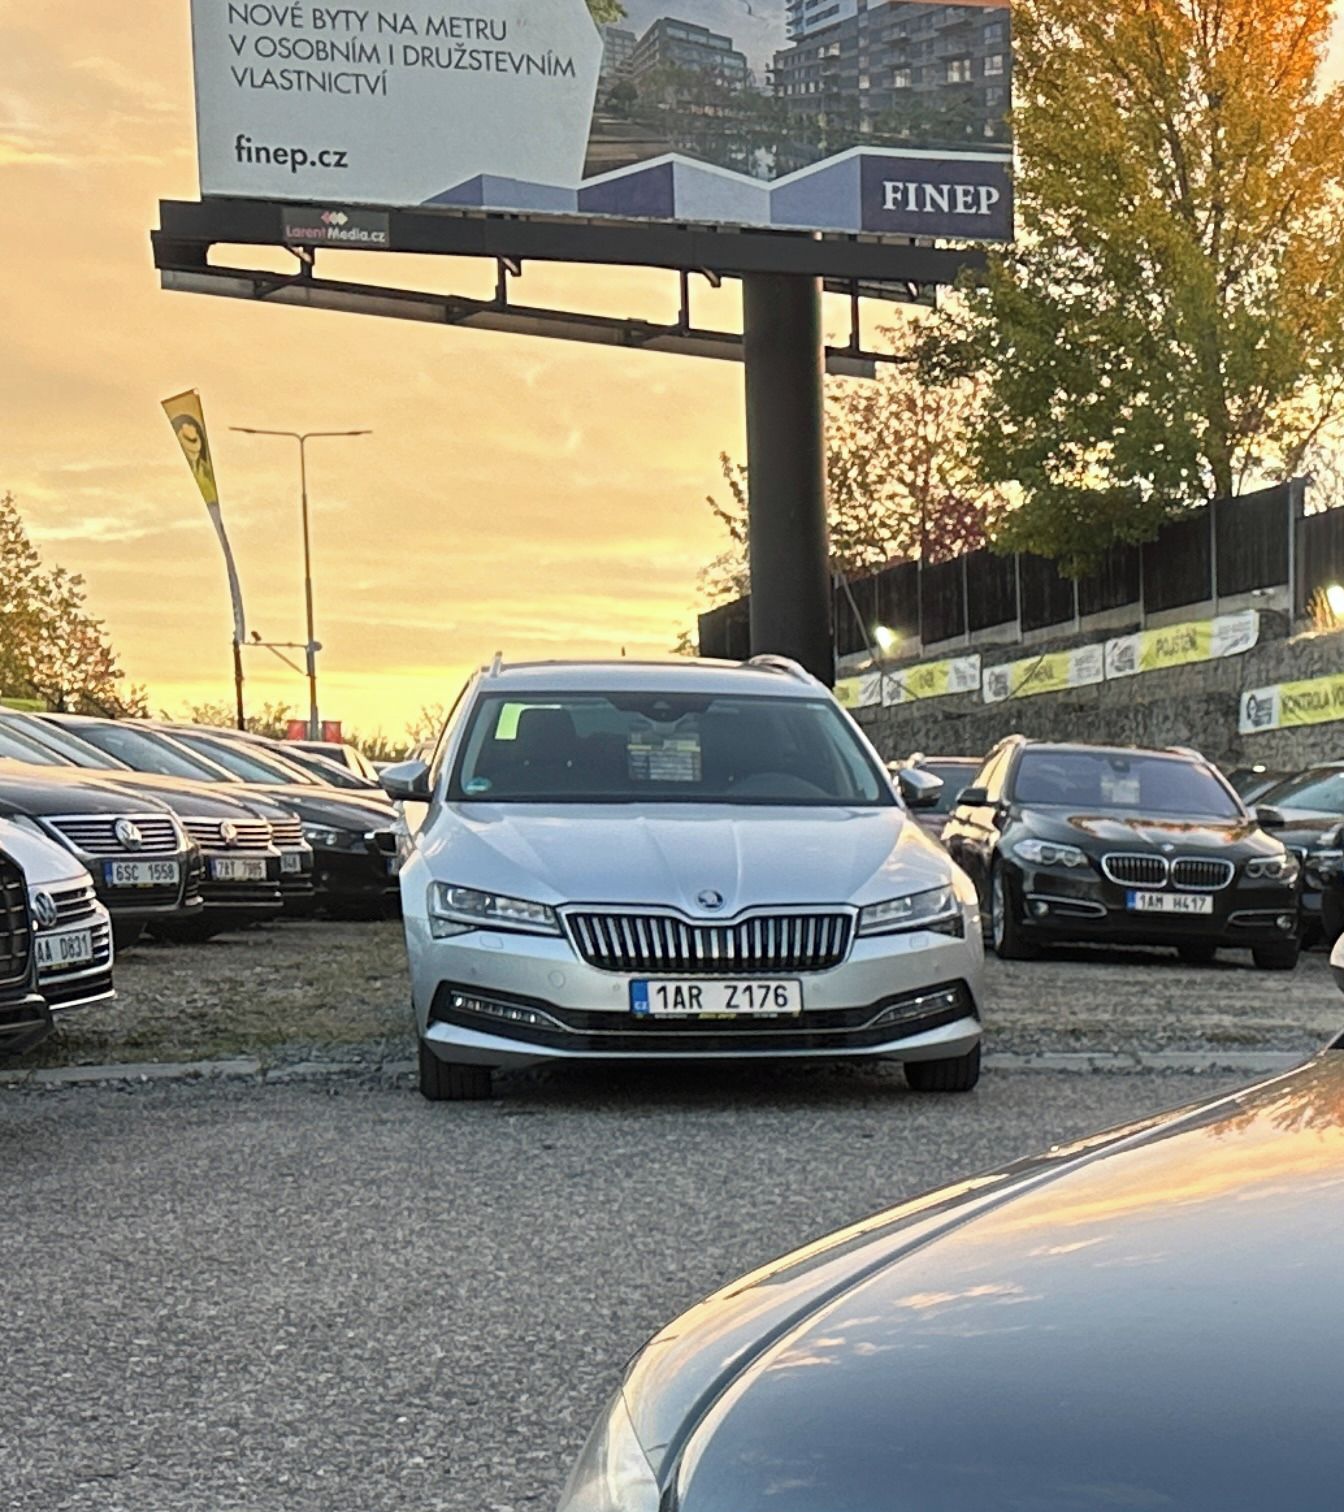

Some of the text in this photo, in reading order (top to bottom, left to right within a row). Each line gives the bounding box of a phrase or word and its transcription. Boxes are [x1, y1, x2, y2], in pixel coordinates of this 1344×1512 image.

[228, 2, 507, 41] NOVÉ BYTY NA METRU
[228, 34, 247, 57] V
[254, 36, 381, 64] OSOBNÍM
[403, 44, 576, 78] DRUŽSTEVNÍM
[230, 66, 388, 96] VLASTNICTVÍ
[235, 134, 348, 173] finep.cz
[883, 181, 999, 215] FINEP
[116, 865, 139, 882] 6SC
[1140, 894, 1163, 911] 1AM
[657, 985, 788, 1009] 1AR Z176
